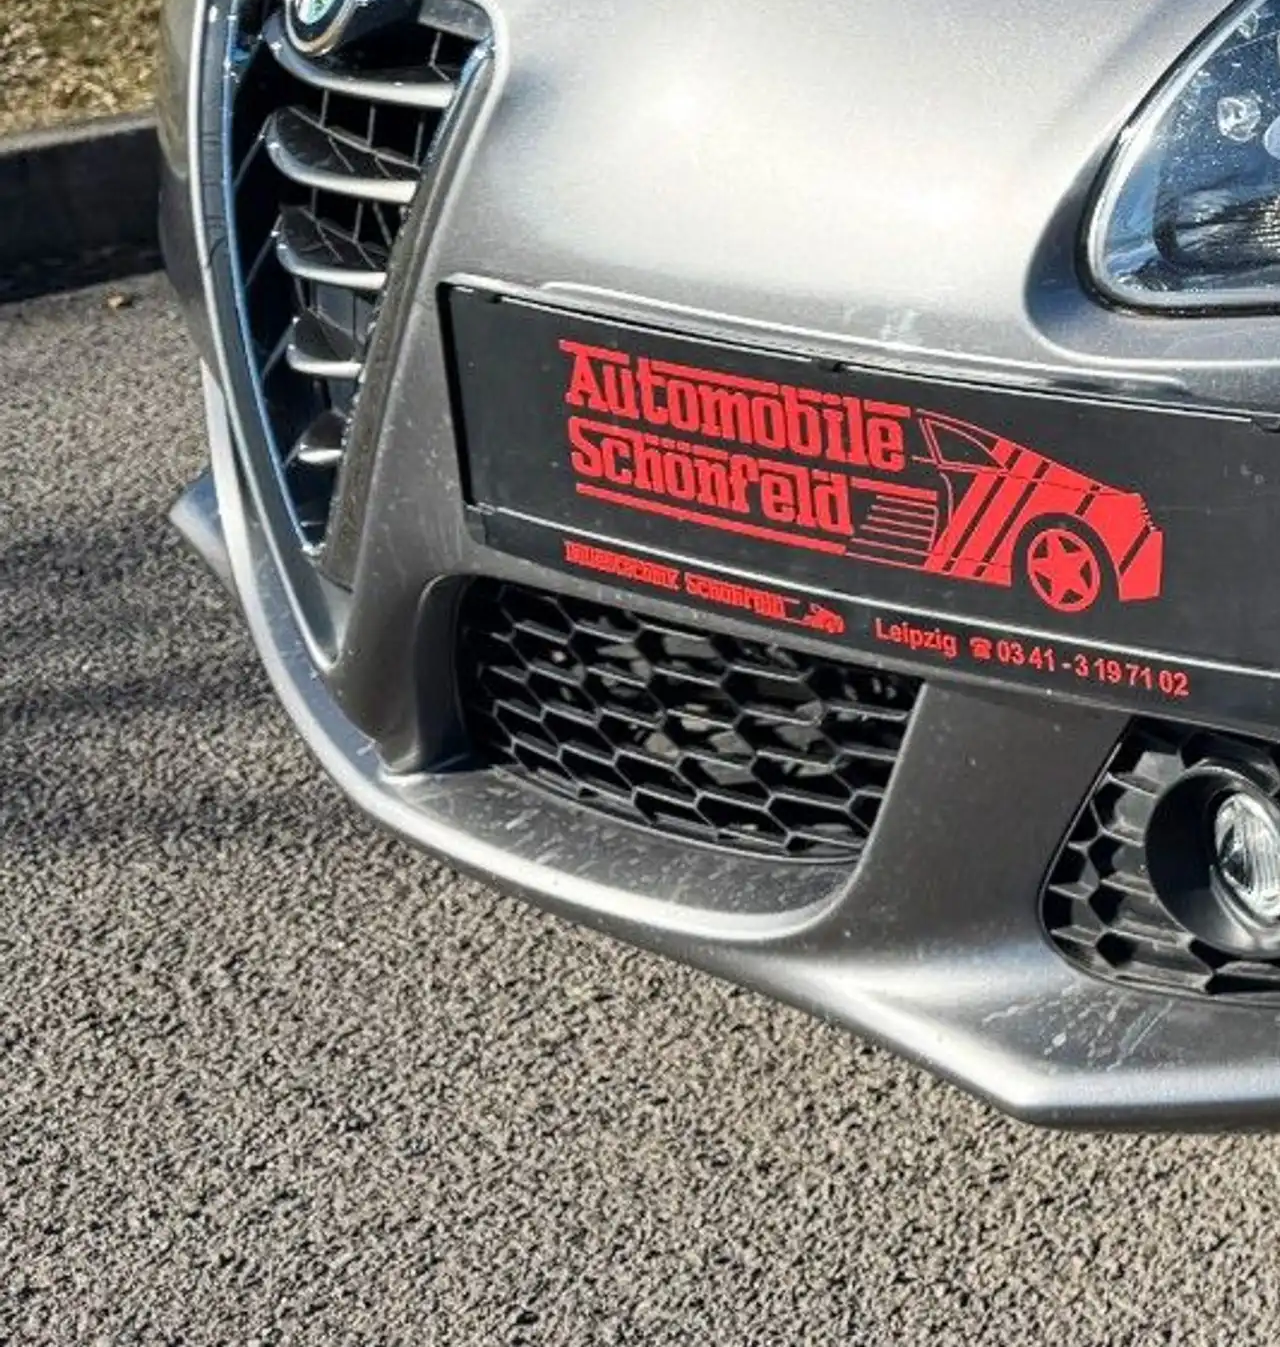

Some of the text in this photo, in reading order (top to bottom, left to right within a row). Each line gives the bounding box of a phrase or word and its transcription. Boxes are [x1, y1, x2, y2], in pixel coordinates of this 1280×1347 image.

[560, 339, 911, 472] Automobile
[569, 416, 854, 534] Schönfeld
[874, 617, 958, 658] Leipzig
